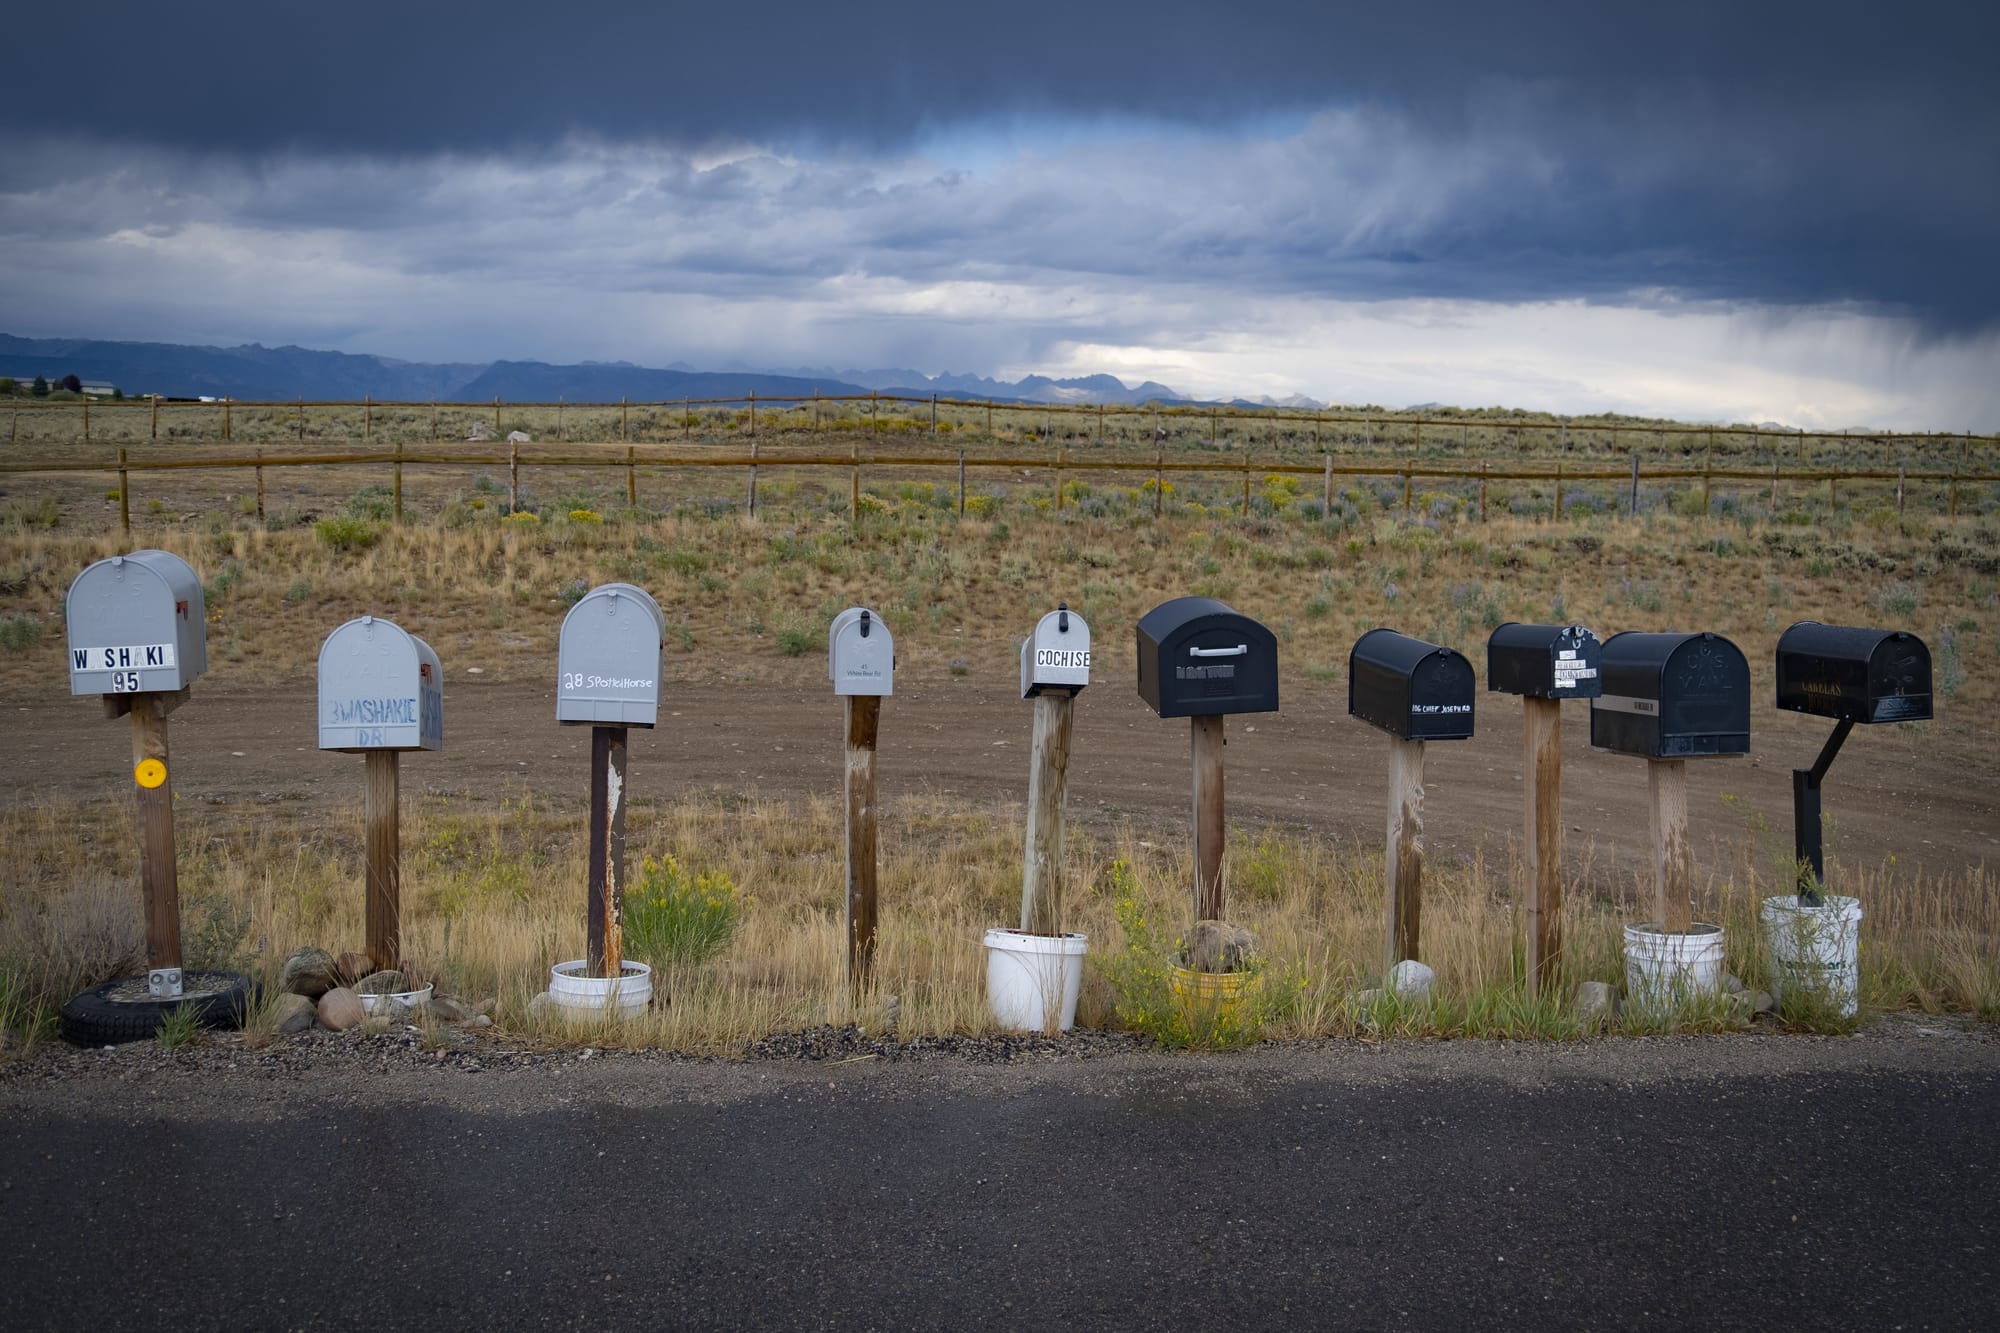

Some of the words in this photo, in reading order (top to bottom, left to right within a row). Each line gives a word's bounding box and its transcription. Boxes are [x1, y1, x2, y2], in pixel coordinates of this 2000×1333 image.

[1037, 650, 1091, 667] COCHISE
[113, 672, 138, 692] 95
[563, 672, 583, 690] 28
